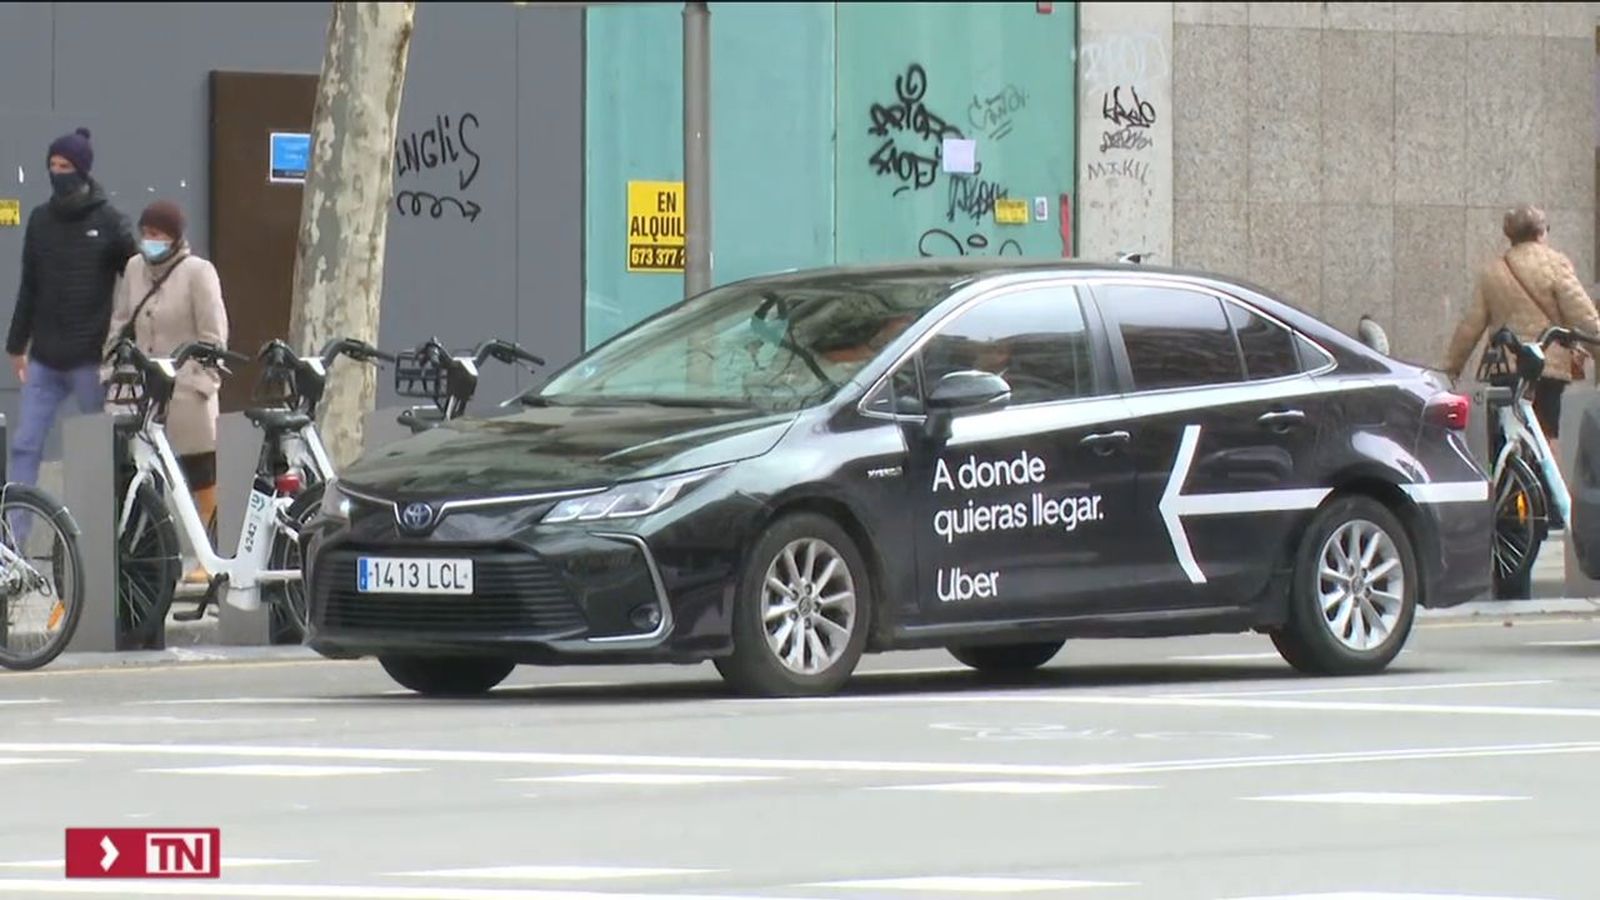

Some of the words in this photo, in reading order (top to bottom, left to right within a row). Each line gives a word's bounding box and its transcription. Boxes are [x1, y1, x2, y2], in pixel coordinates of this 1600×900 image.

[658, 192, 676, 212] EN
[632, 248, 654, 265] 673
[656, 249, 677, 265] 377
[932, 458, 955, 491] A
[958, 450, 1046, 489] donde
[934, 499, 1028, 544] quieras
[1032, 493, 1104, 531] llegar.
[375, 562, 420, 588] 1413
[427, 563, 465, 589] LCL
[937, 567, 1000, 602] Uber
